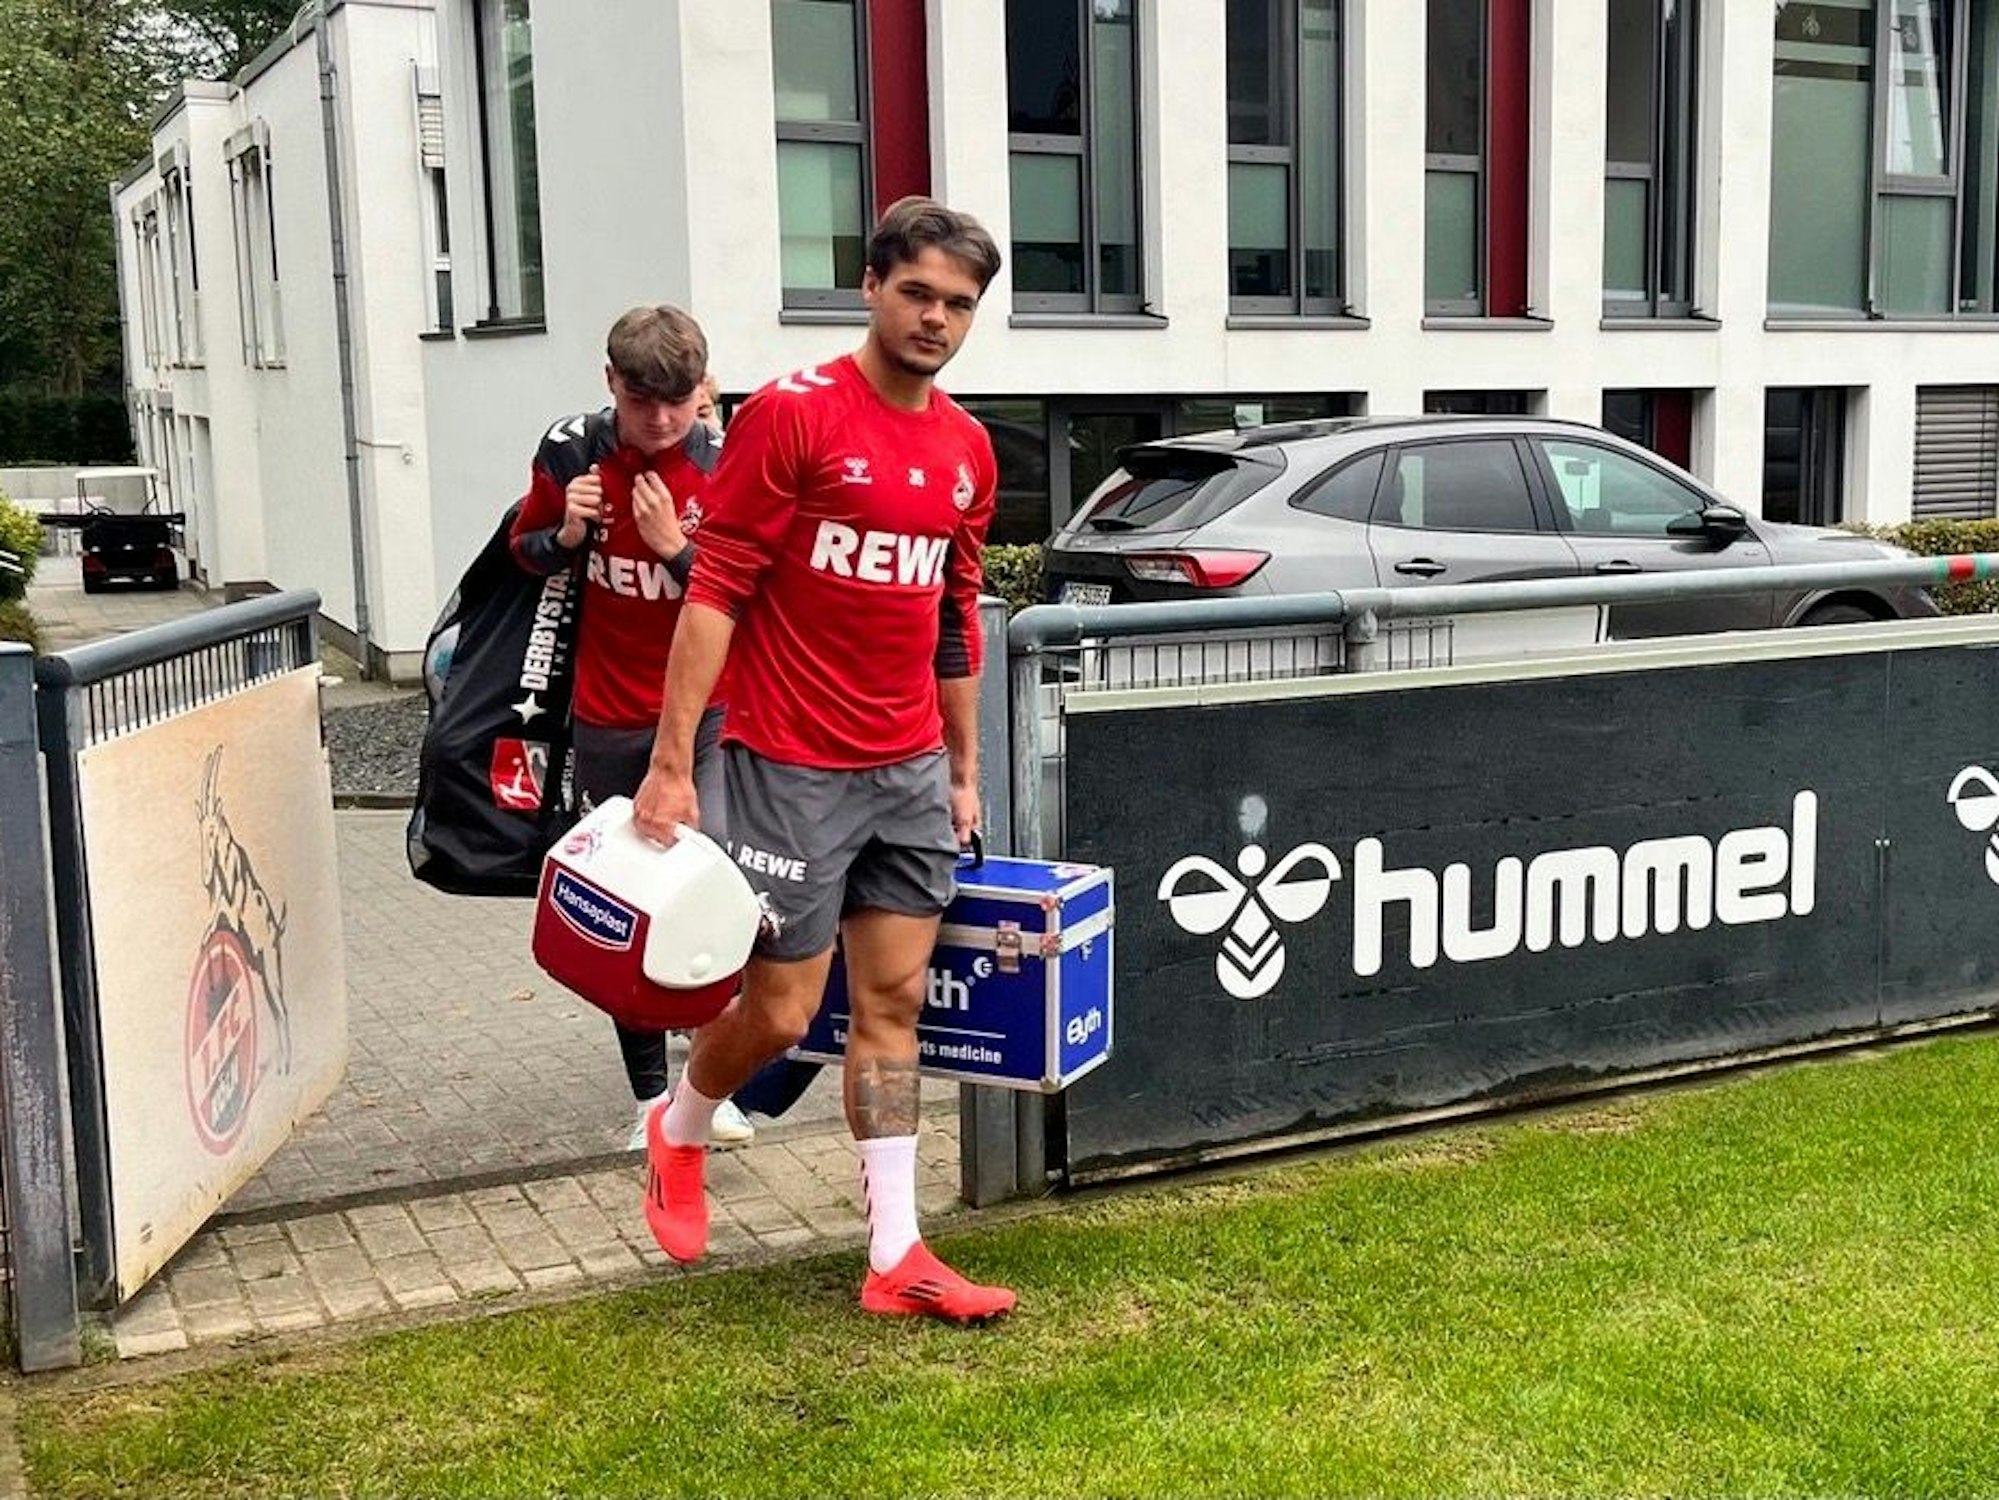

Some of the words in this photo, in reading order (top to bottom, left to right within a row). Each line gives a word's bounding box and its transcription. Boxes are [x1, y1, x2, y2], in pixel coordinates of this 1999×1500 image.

[587, 550, 682, 600] REW
[738, 844, 808, 882] REWE
[1353, 789, 1818, 977] hummel
[557, 882, 629, 938] Hansaplast
[939, 1044, 1003, 1065] medicine
